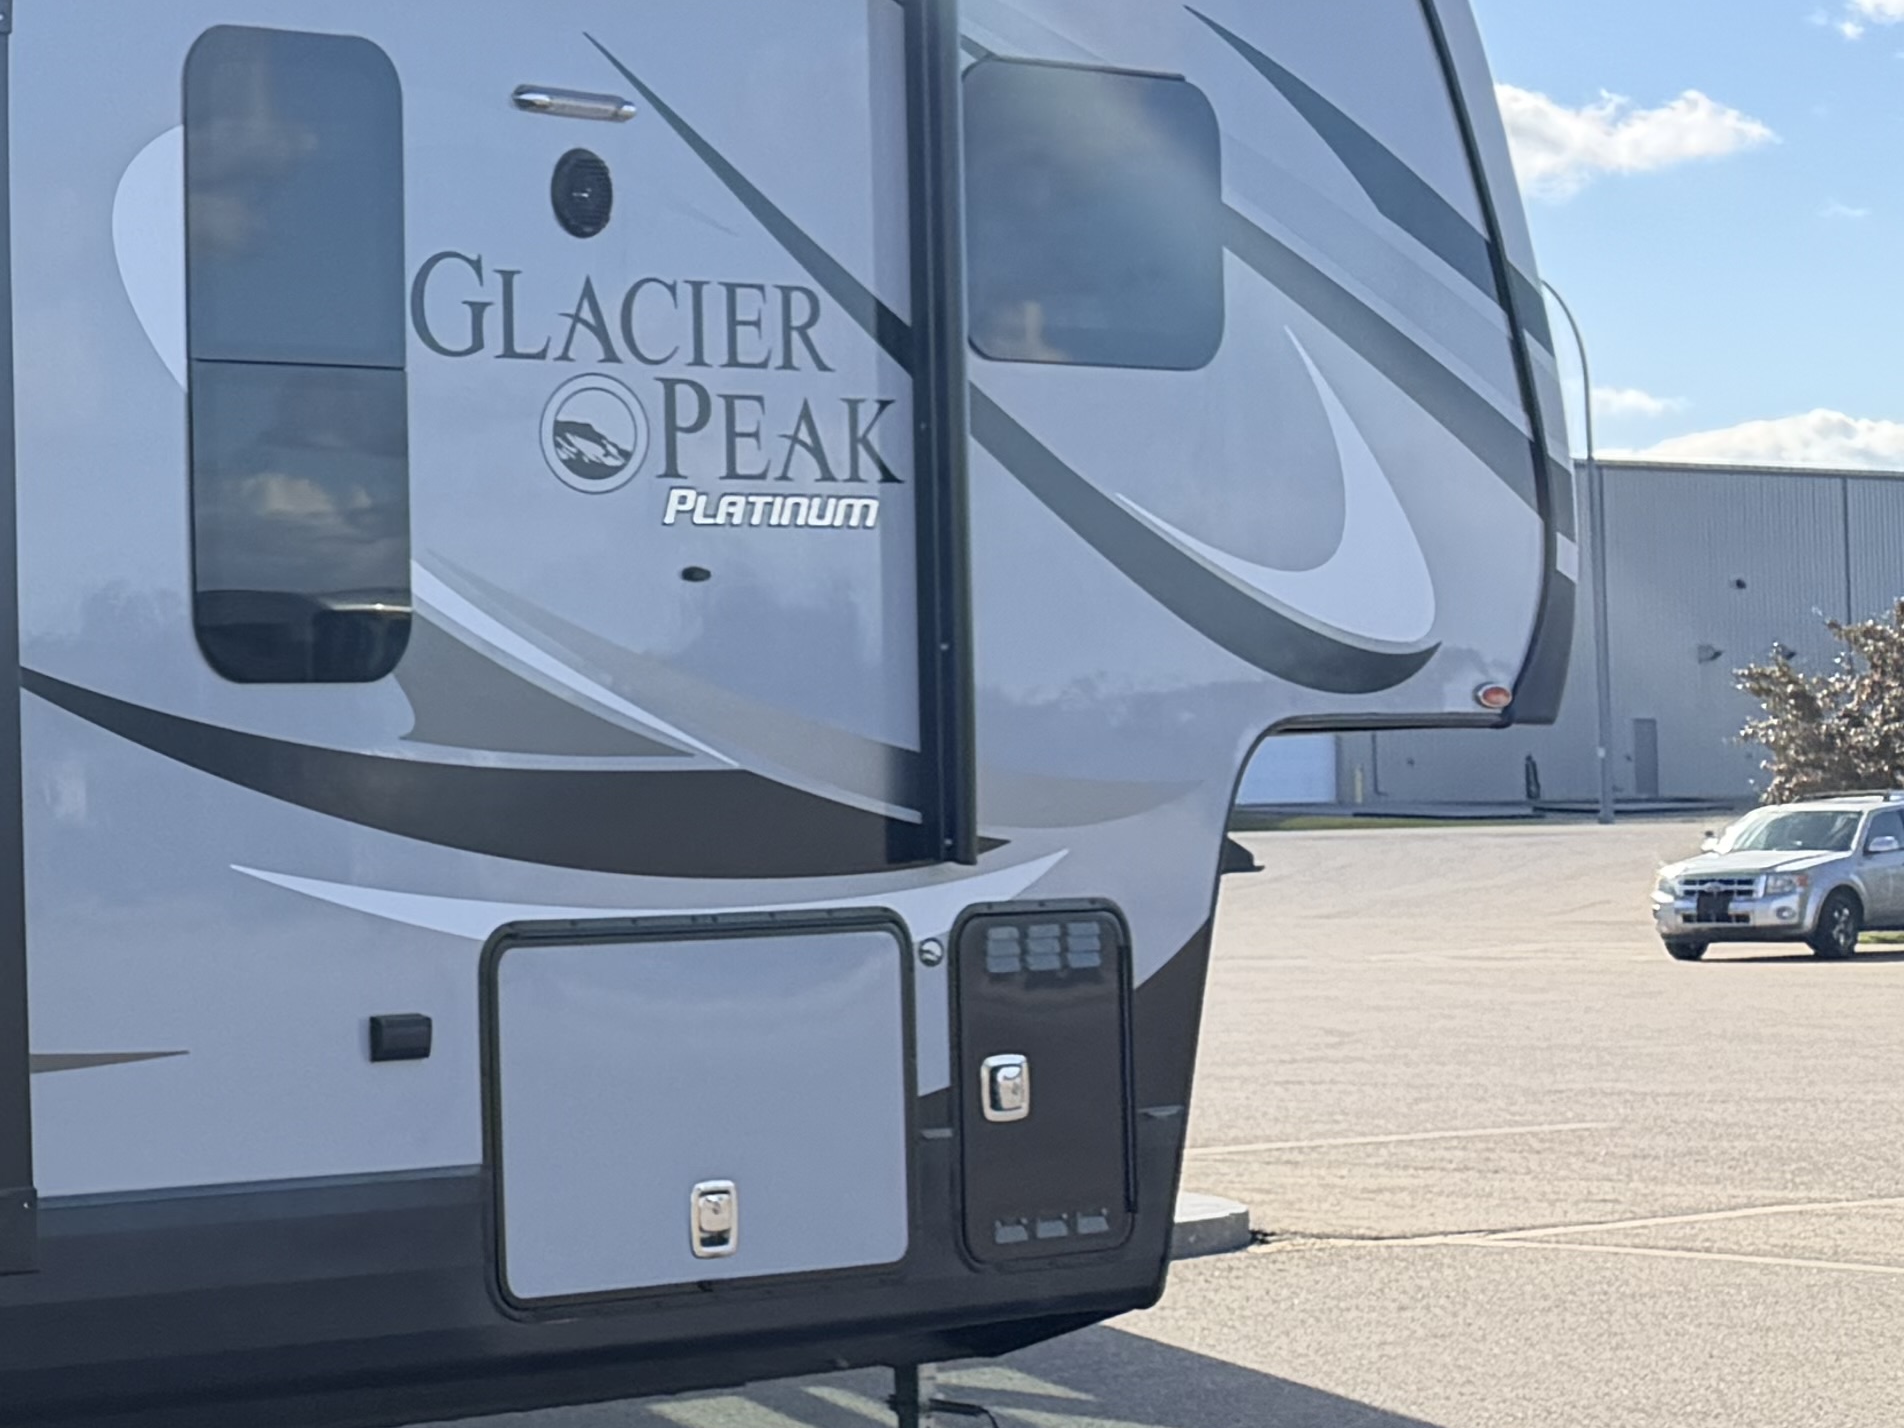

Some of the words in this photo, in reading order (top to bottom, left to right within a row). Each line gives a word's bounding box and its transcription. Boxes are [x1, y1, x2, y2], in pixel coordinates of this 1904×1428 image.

[410, 250, 836, 372] GLACIER
[653, 377, 906, 485] PEAK
[662, 486, 880, 529] PLATINUM
